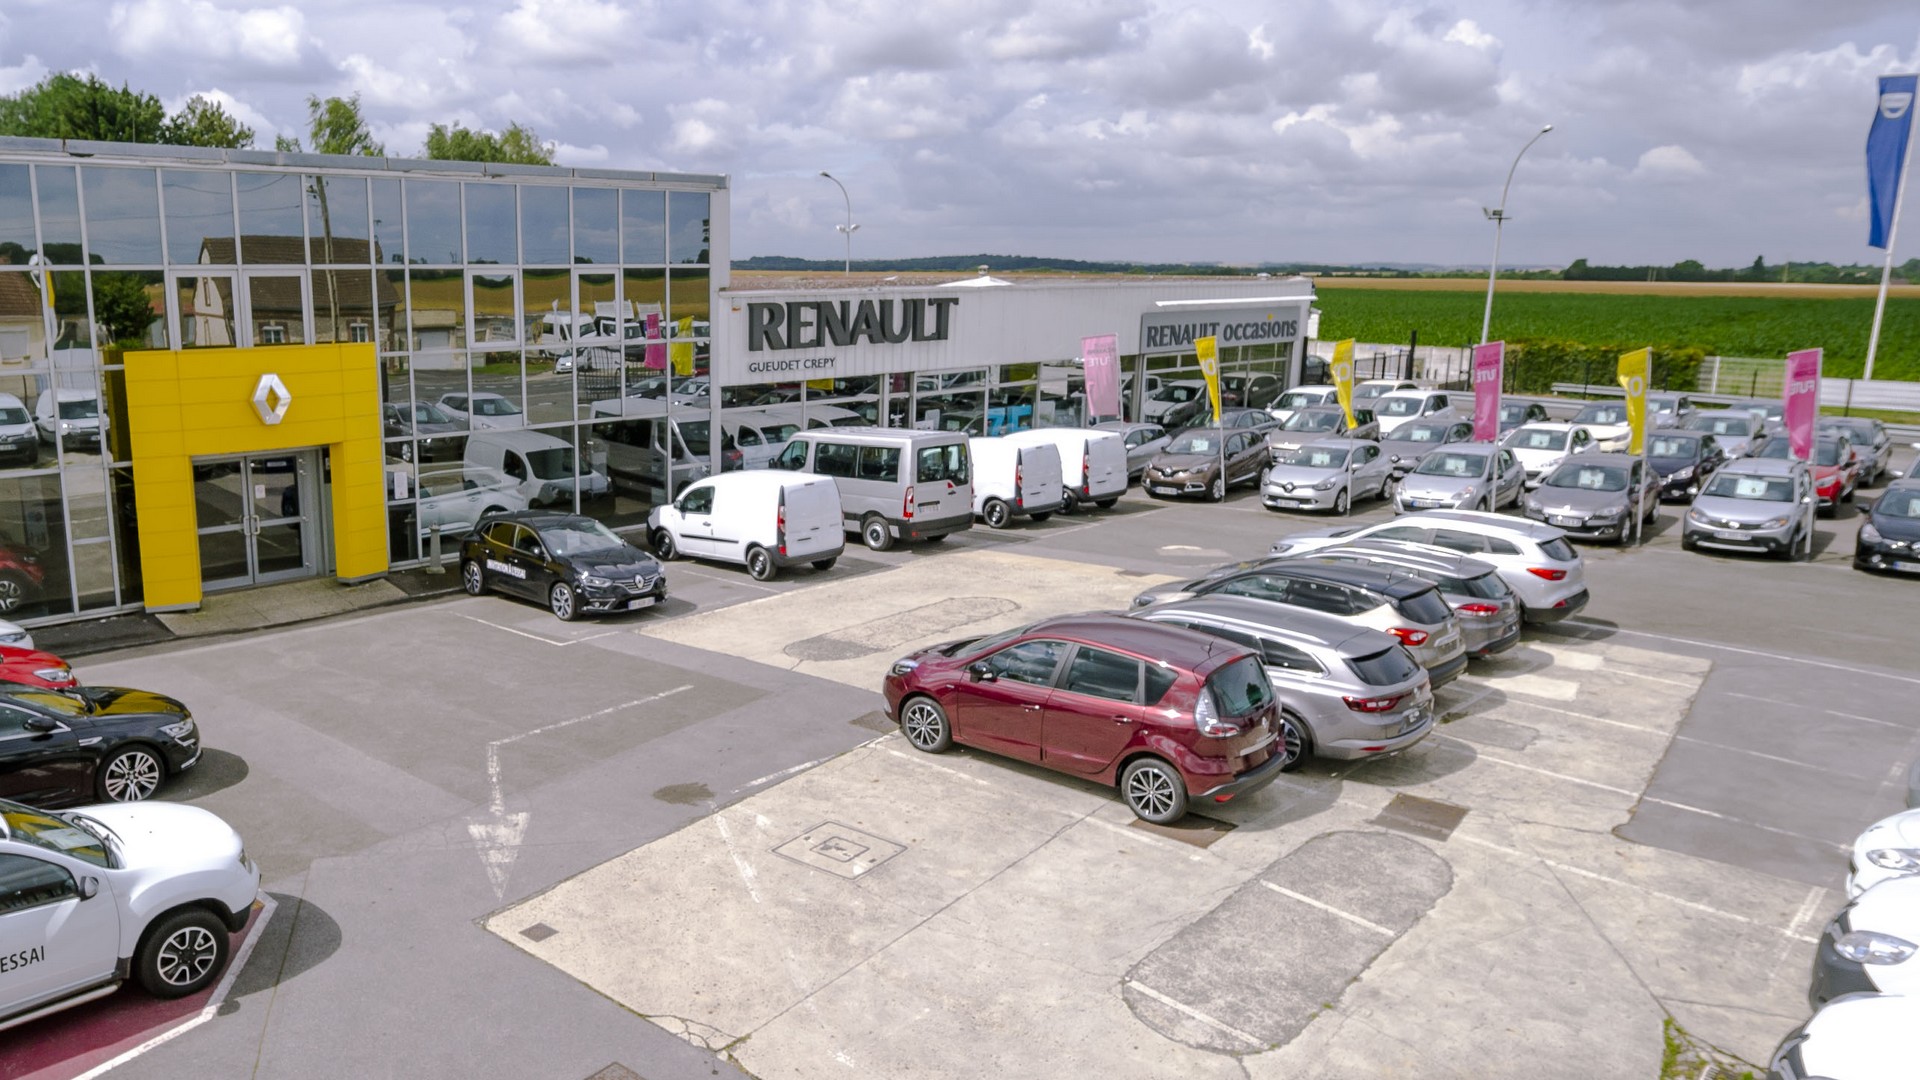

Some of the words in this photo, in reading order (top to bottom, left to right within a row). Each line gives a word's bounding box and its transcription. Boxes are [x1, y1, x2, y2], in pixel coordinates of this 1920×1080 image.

[748, 298, 959, 351] RENAULT
[1146, 322, 1219, 348] RENAULT
[1223, 313, 1298, 342] occasions
[749, 359, 800, 373] GUEUDET
[803, 357, 836, 369] CREPY
[0, 945, 45, 974] ESSAI
